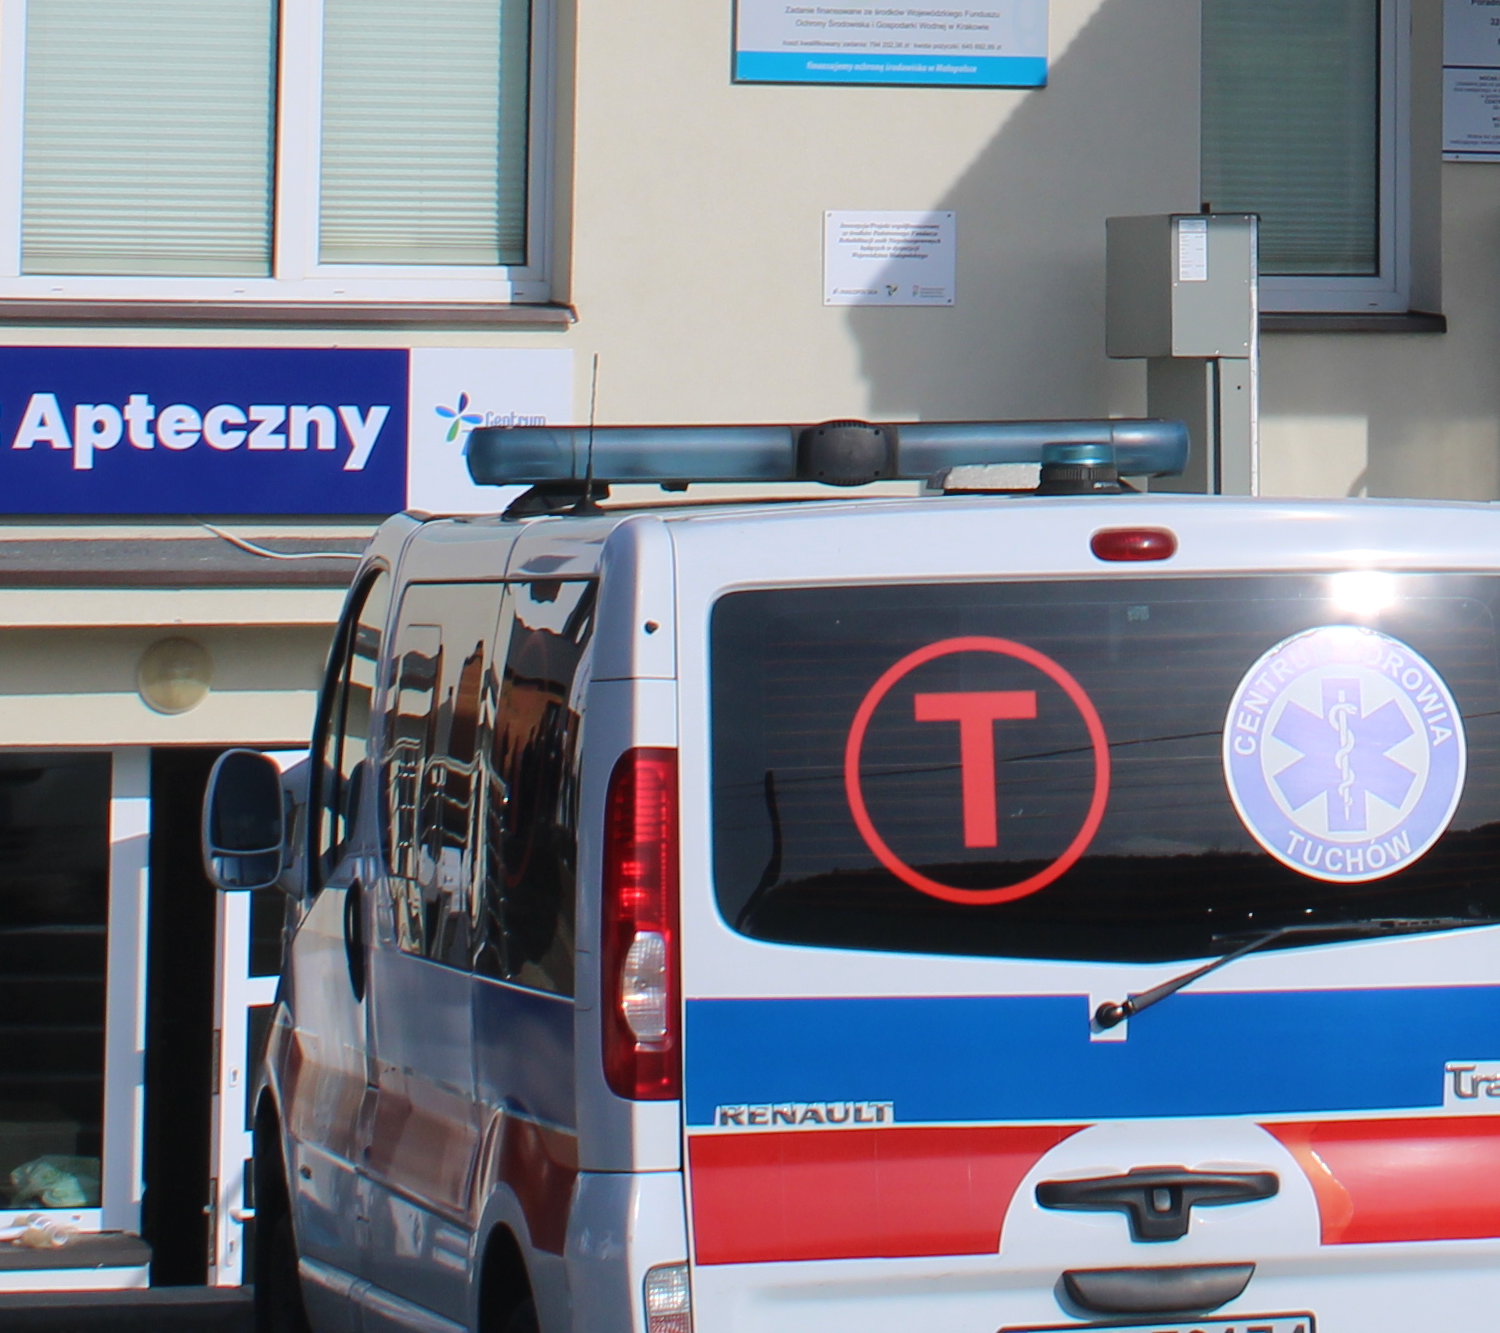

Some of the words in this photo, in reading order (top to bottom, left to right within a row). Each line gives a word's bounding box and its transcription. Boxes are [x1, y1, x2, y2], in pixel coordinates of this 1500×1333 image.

[14, 391, 391, 471] Apteczny
[485, 410, 546, 429] Centrum
[1348, 641, 1453, 747] DROWIA
[913, 689, 1037, 848] T
[1285, 829, 1412, 873] TUCHÓW
[719, 1101, 894, 1126] RENAULT
